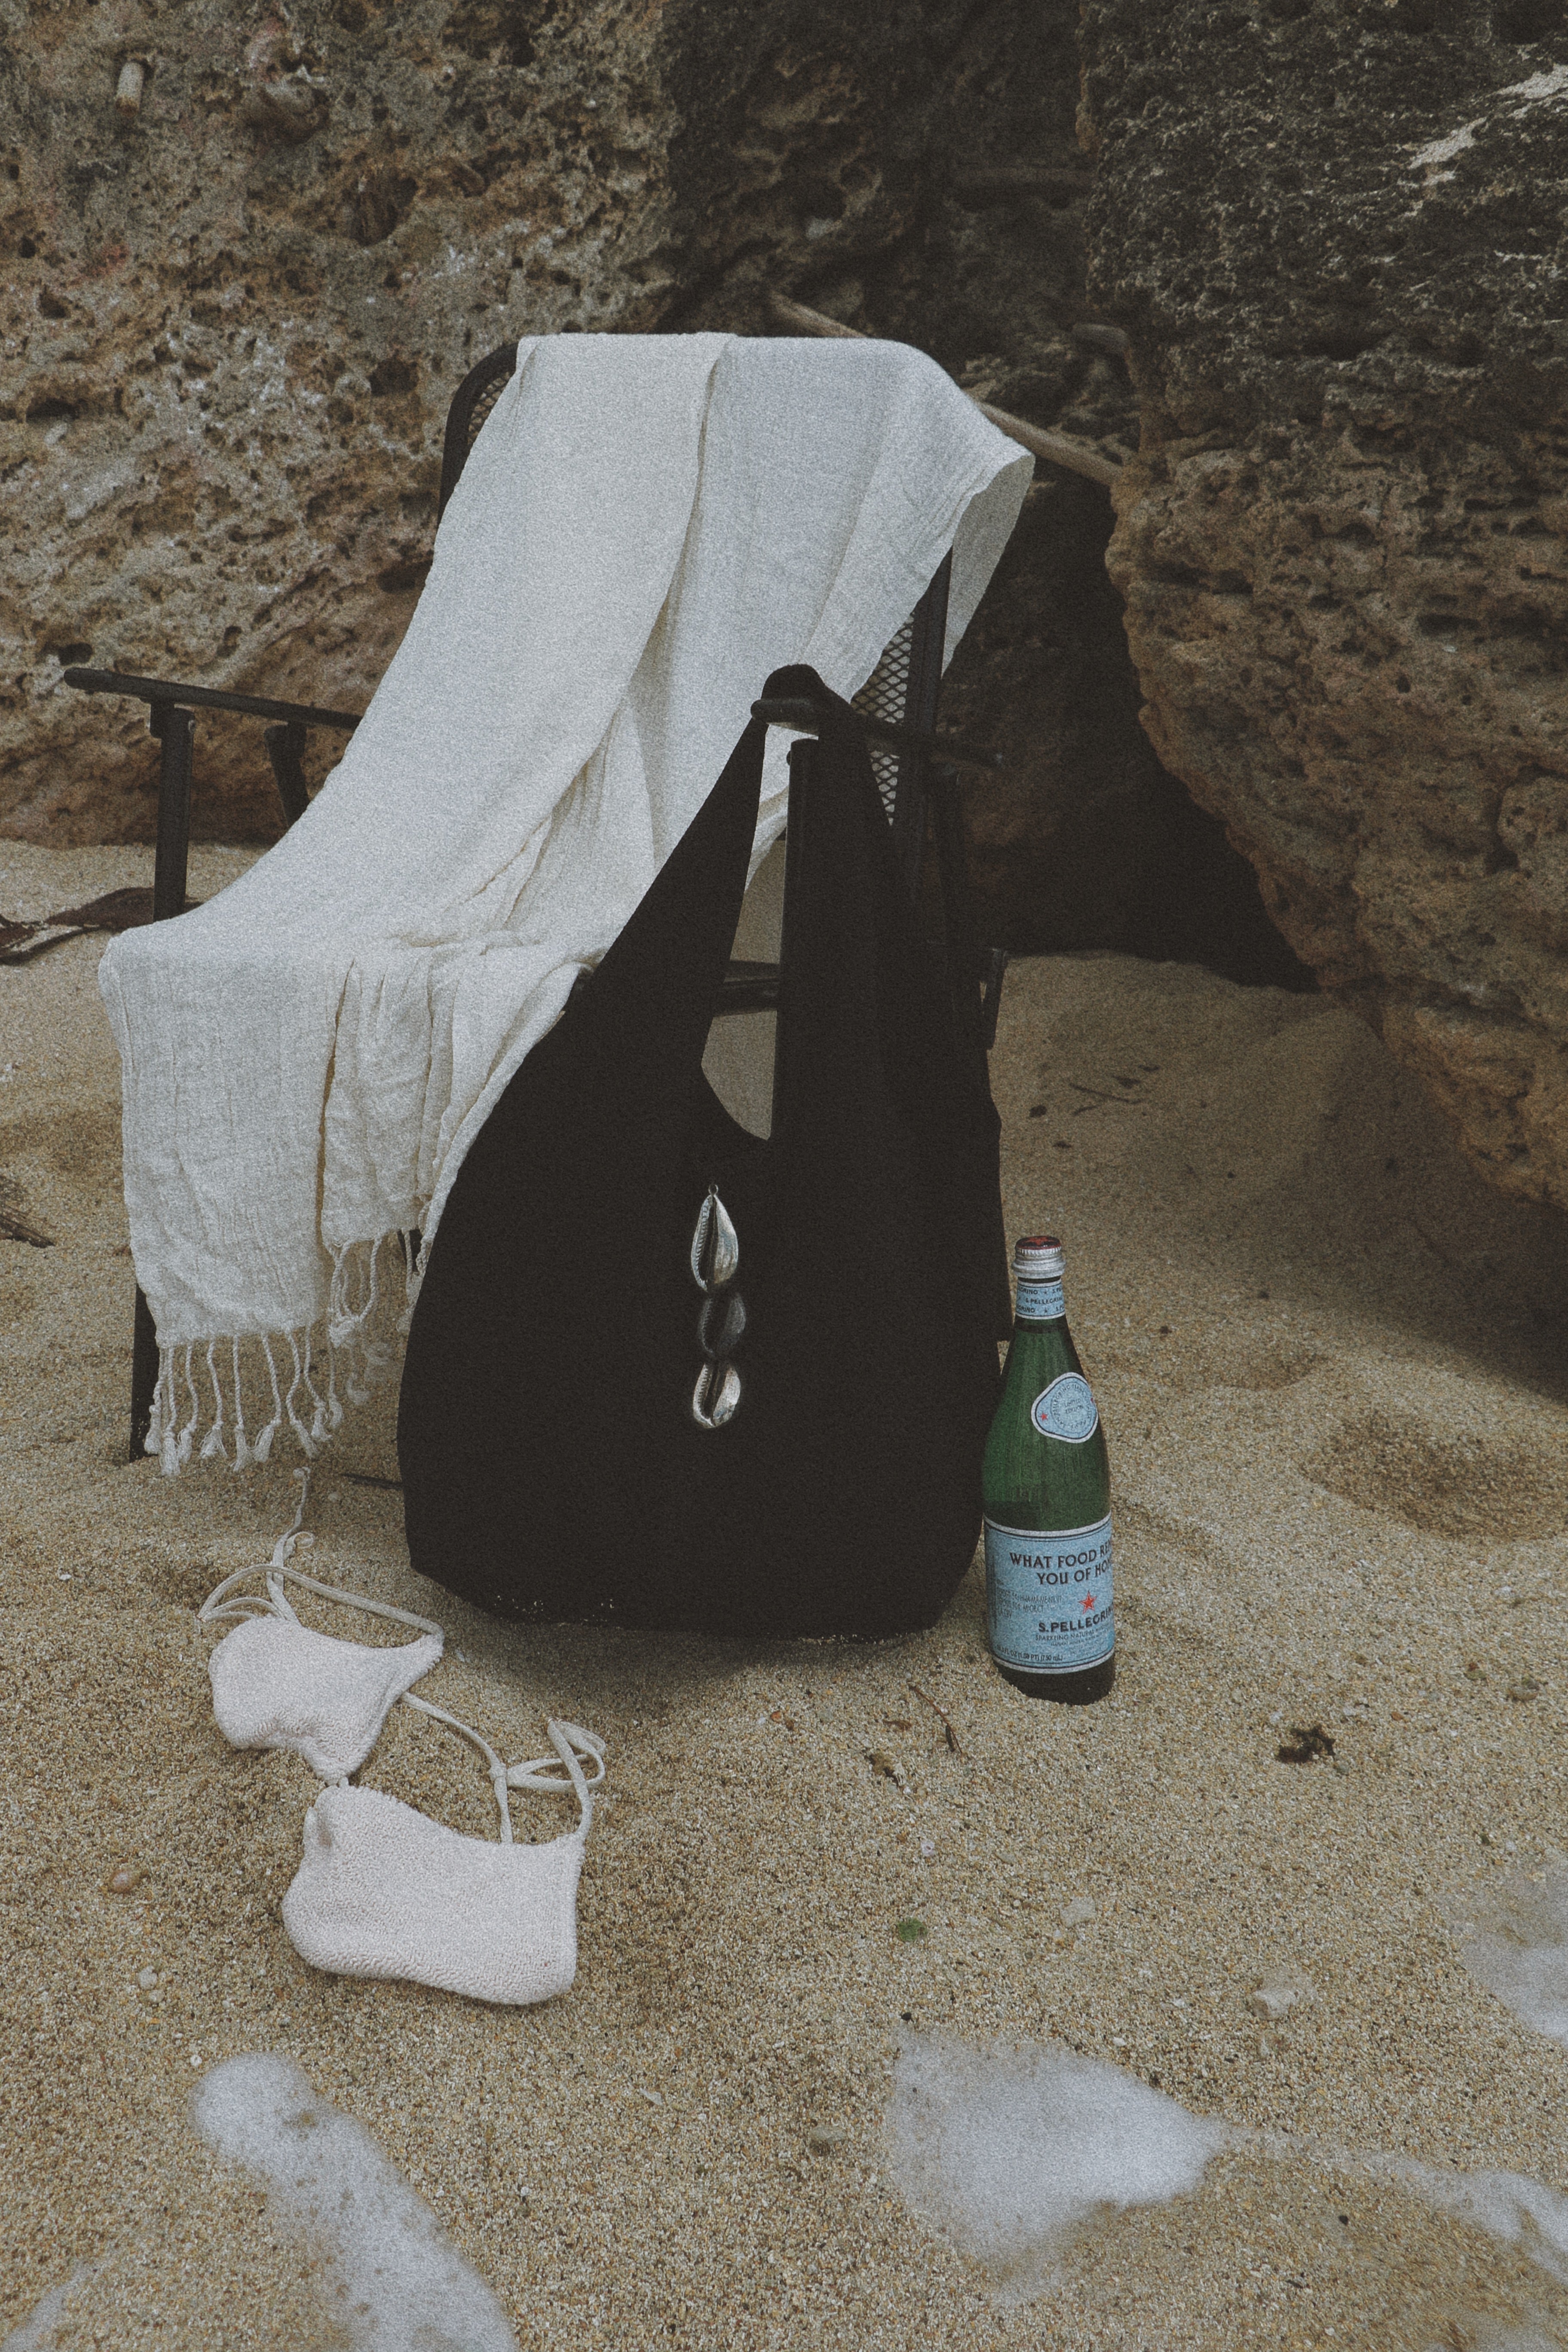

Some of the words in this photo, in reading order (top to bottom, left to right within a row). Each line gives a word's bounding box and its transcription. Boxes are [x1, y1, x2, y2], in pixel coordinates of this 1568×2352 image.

[1018, 1286, 1038, 1295] EGRINO
[1017, 1304, 1035, 1313] EGRINO
[1009, 1552, 1052, 1568] WHAT
[1058, 1550, 1097, 1568] FOOD
[1037, 1572, 1069, 1585] YOU
[1074, 1568, 1091, 1582] OF
